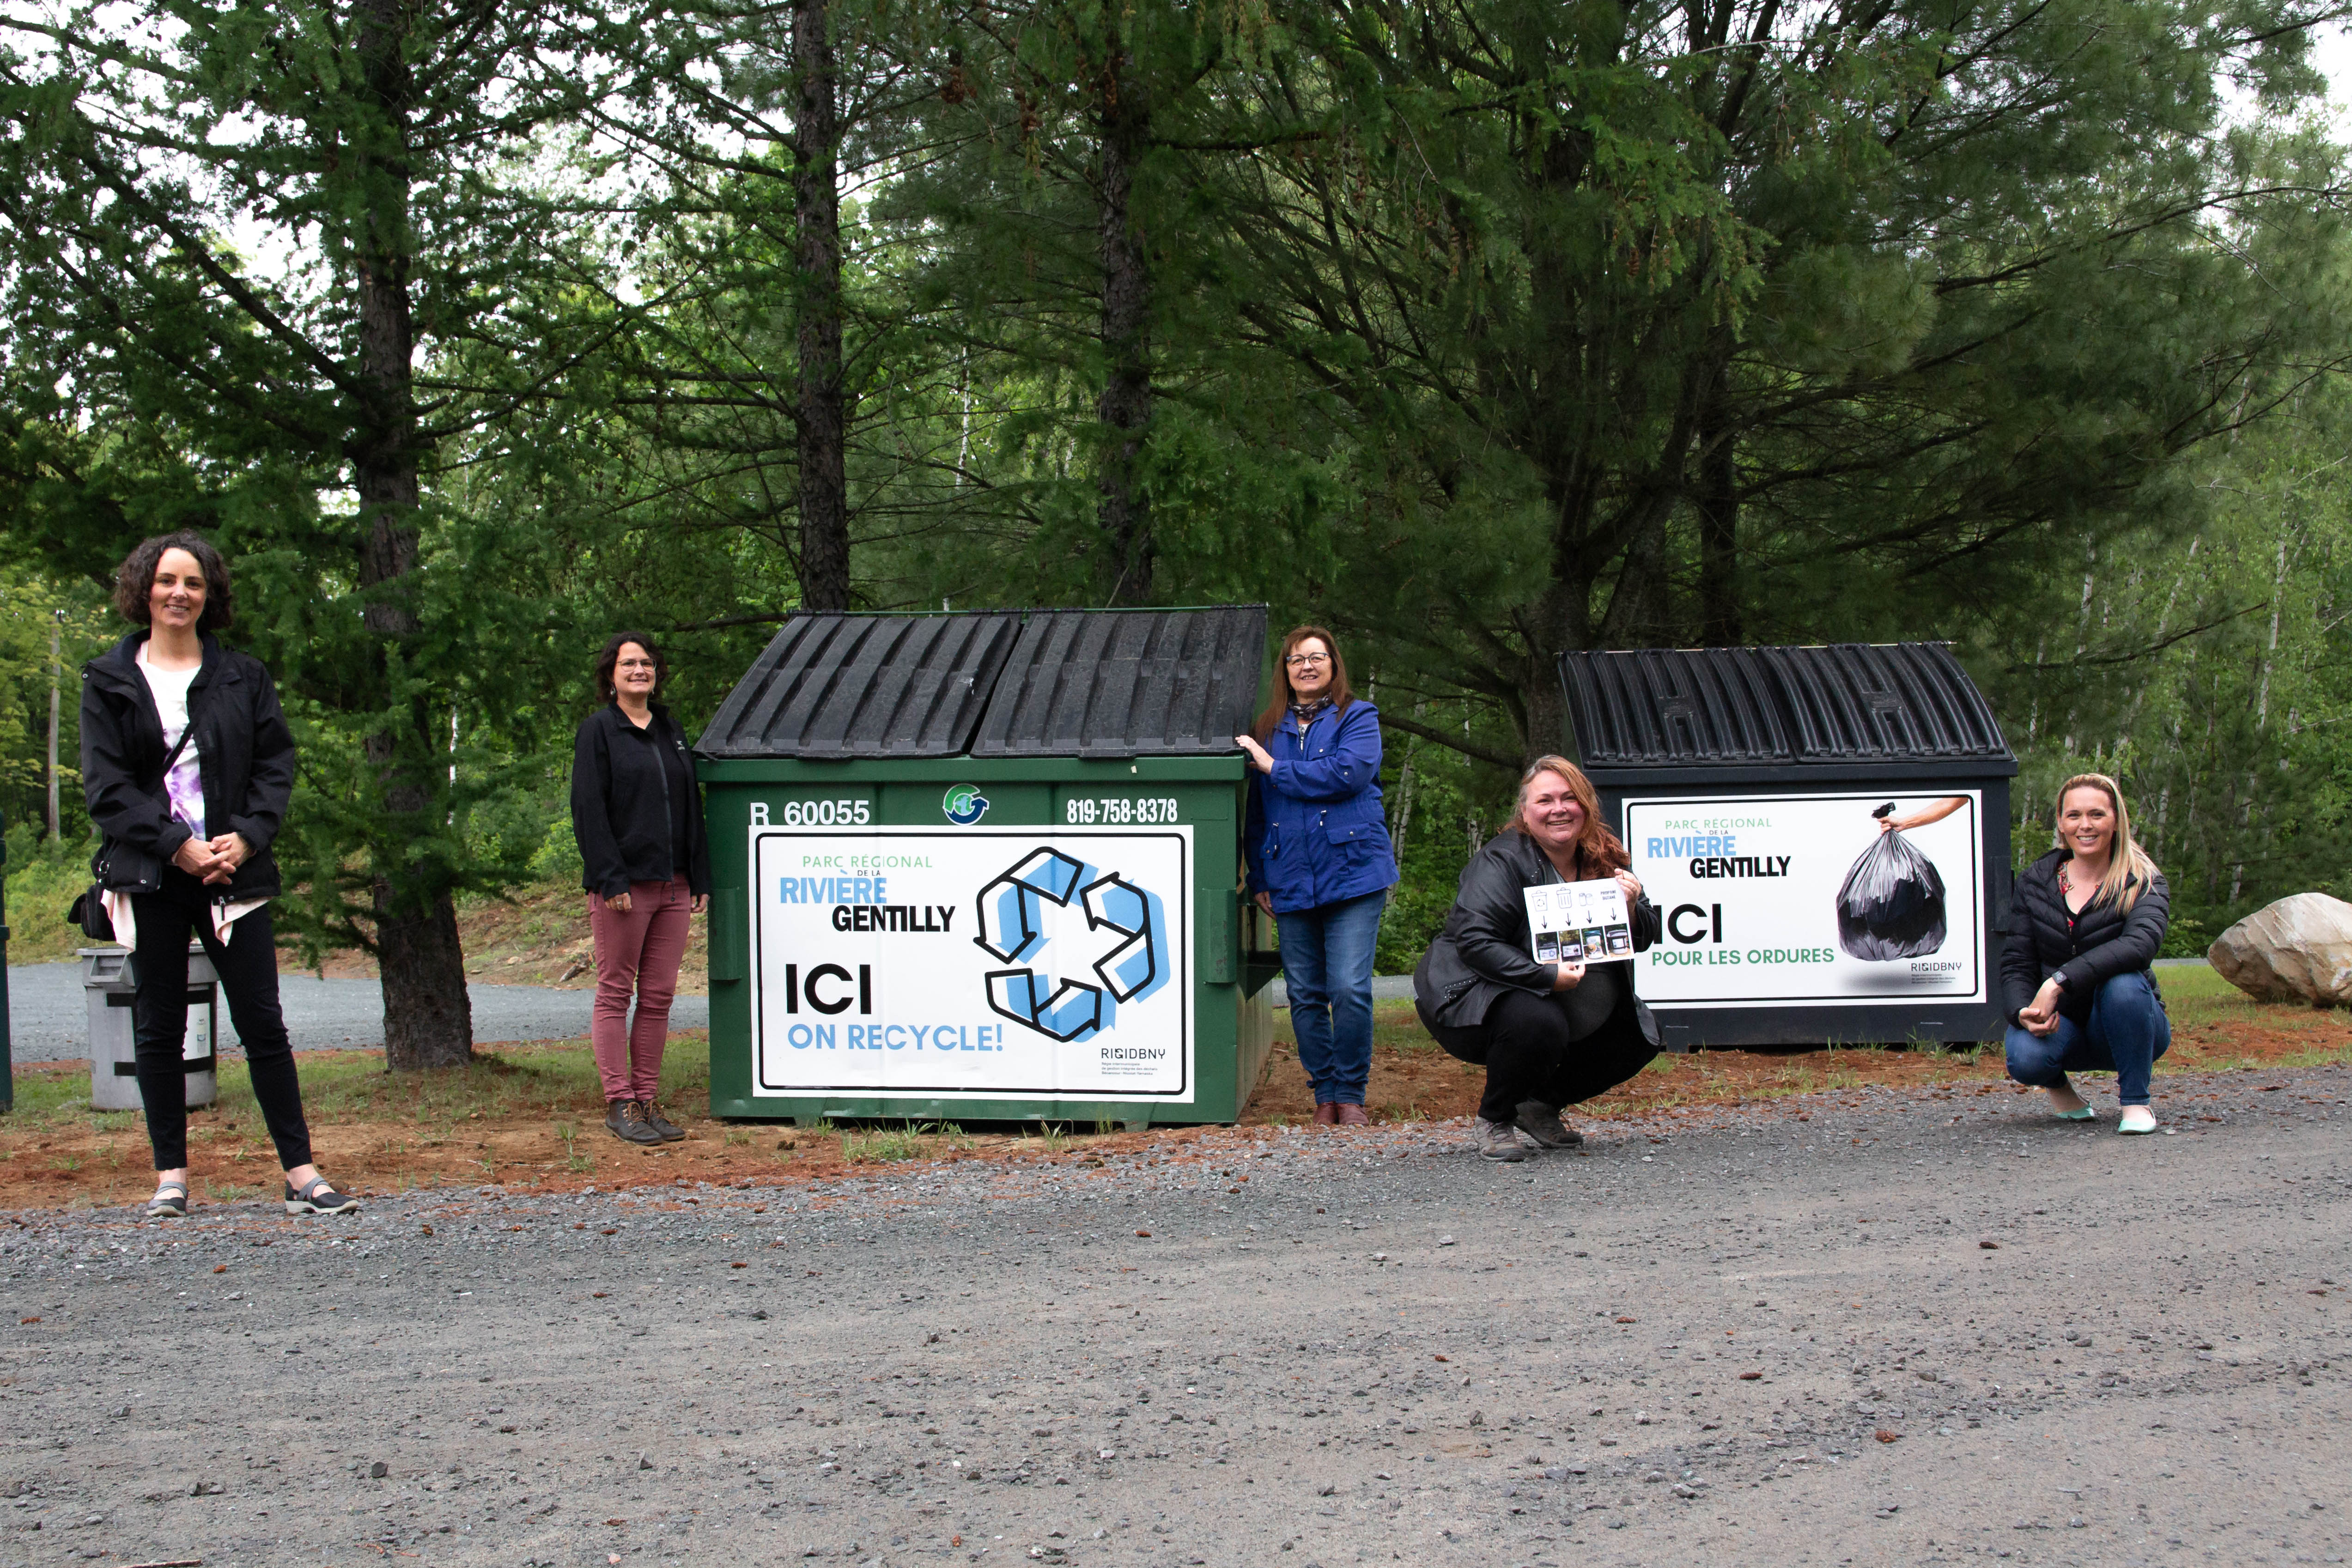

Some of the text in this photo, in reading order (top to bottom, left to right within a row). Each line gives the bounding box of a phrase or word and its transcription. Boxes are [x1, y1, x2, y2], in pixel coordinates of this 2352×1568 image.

[750, 800, 869, 825] R 60055
[1067, 798, 1178, 823] 819-758-8378
[1665, 817, 1772, 830] PARC RÉGIONAL
[1647, 830, 1736, 858] RIVIÈRE
[803, 853, 933, 868] PARC RÉGIONAL
[1690, 856, 1791, 878] GENTILLY
[779, 869, 887, 904] RIVIÈRE
[832, 905, 956, 932] GENTILLY
[1653, 904, 1722, 944] ICI
[1652, 948, 1835, 966] POUR LES ORDURES
[1911, 962, 1962, 972] RIGIDBNY
[785, 963, 872, 1015] ICI
[788, 1023, 1003, 1051] ON RECYCLE!
[1101, 1048, 1165, 1059] RIGIDBNY
